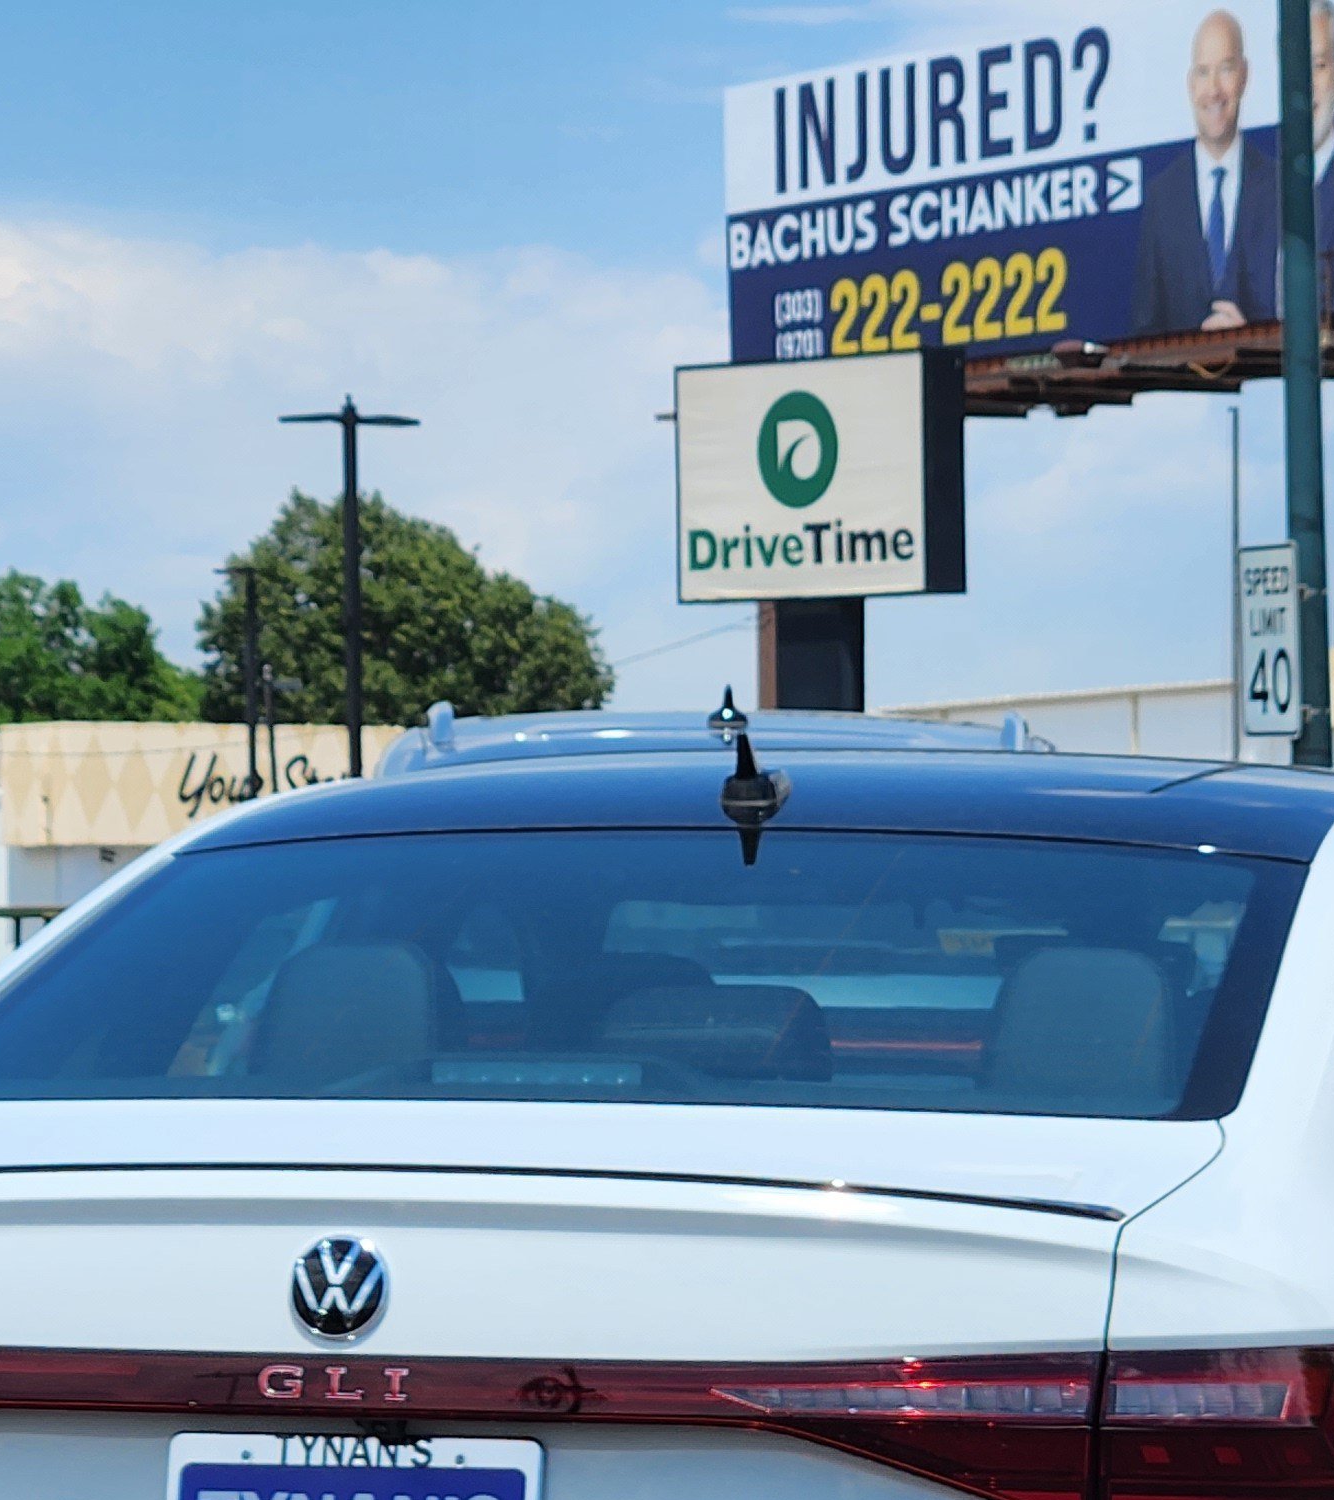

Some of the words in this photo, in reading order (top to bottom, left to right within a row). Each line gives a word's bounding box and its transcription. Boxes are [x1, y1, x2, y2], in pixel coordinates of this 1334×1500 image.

[773, 26, 1111, 195] INJURED?
[729, 200, 878, 271] BACHUS
[887, 165, 1100, 248] SCHANKER
[774, 287, 824, 328] (303)
[830, 246, 1067, 355] 222-2222
[688, 519, 915, 571] DriveTime
[1244, 565, 1289, 597] SPEED
[1249, 606, 1286, 637] LIMIT
[1248, 648, 1292, 714] 40
[178, 752, 264, 818] You
[292, 1238, 387, 1336] VW
[257, 1364, 410, 1402] GLI
